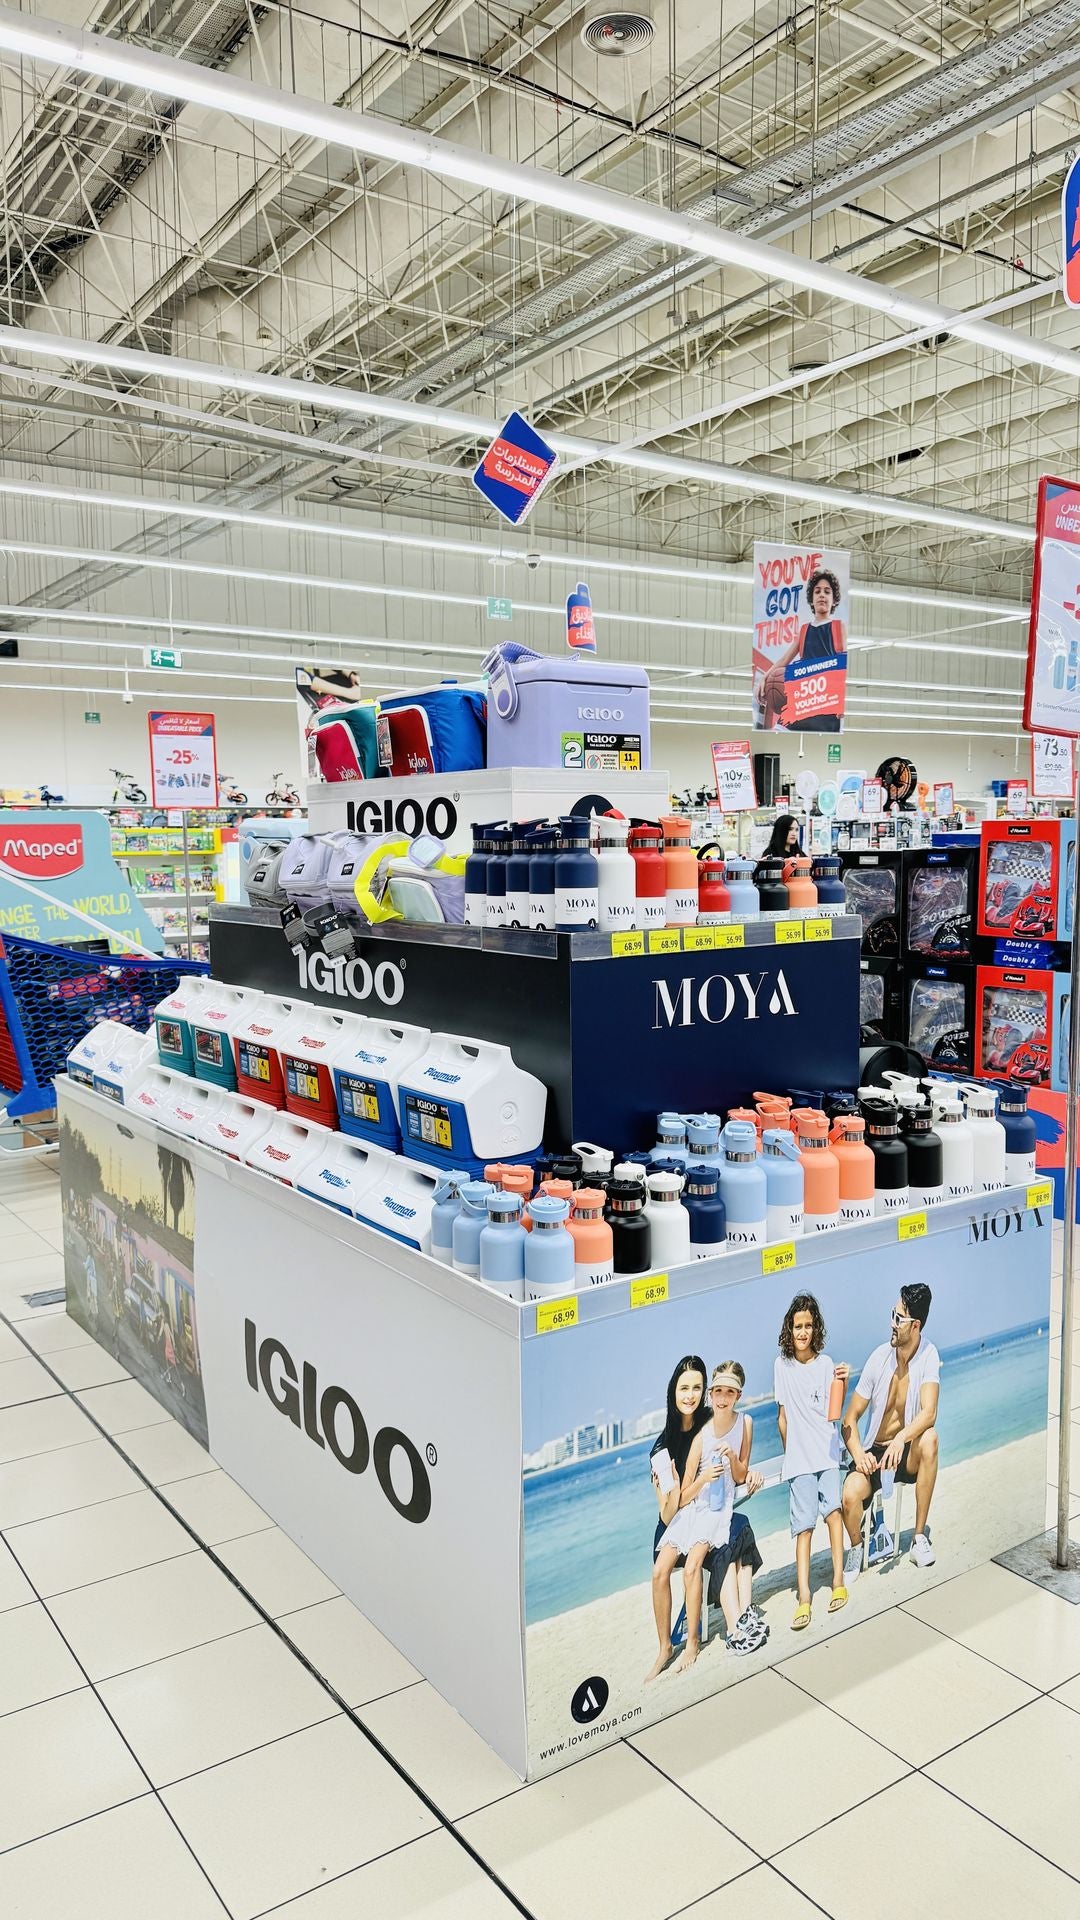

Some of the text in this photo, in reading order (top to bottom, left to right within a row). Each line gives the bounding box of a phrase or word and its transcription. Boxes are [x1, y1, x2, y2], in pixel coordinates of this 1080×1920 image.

[493, 445, 544, 476] مستلزمات
[495, 460, 537, 488] المدرسة
[766, 585, 803, 617] GOT
[755, 615, 800, 650] THIS!
[794, 658, 838, 677] 500 WINNERS
[800, 676, 827, 697] 500
[795, 694, 828, 710] voucher
[577, 707, 624, 721] IGLOO
[586, 734, 618, 744] IGLOO
[563, 740, 583, 768] 2
[407, 752, 428, 772] igloo
[3, 838, 78, 860] Maped
[73, 893, 132, 917] WORLD,
[566, 899, 596, 908] MOYA
[675, 899, 698, 907] MOY
[645, 907, 667, 916] MOY
[943, 915, 972, 929] POWER
[726, 935, 743, 944] 56.99
[785, 931, 801, 939] 56.99
[815, 929, 830, 937] 56.99
[624, 941, 642, 951] 68.99
[660, 940, 679, 949] 68.99
[695, 938, 713, 947] 68.99
[1005, 940, 1033, 949] Double
[1002, 955, 1029, 964] Double
[298, 951, 404, 1006] IGLOO
[651, 968, 800, 1029] MOYA
[943, 1031, 970, 1043] POWER
[423, 1067, 462, 1083] Playmate
[416, 1099, 438, 1112] IGLOO
[263, 1144, 292, 1162] Playmate
[318, 1169, 351, 1188] Playm
[923, 1195, 943, 1206] MOY
[1035, 1192, 1050, 1203] 88.99
[383, 1196, 417, 1220] Playmate
[840, 1208, 871, 1218] MOYA
[909, 1222, 925, 1235] 88.99
[967, 1204, 1045, 1246] MOYA
[775, 1252, 793, 1266] 88.99
[589, 1272, 614, 1285] MOY
[645, 1286, 666, 1300] 68.99
[552, 1309, 575, 1324] 68.99
[245, 1317, 432, 1524] IGLOO
[539, 1706, 642, 1760] www.lovemoya.com
